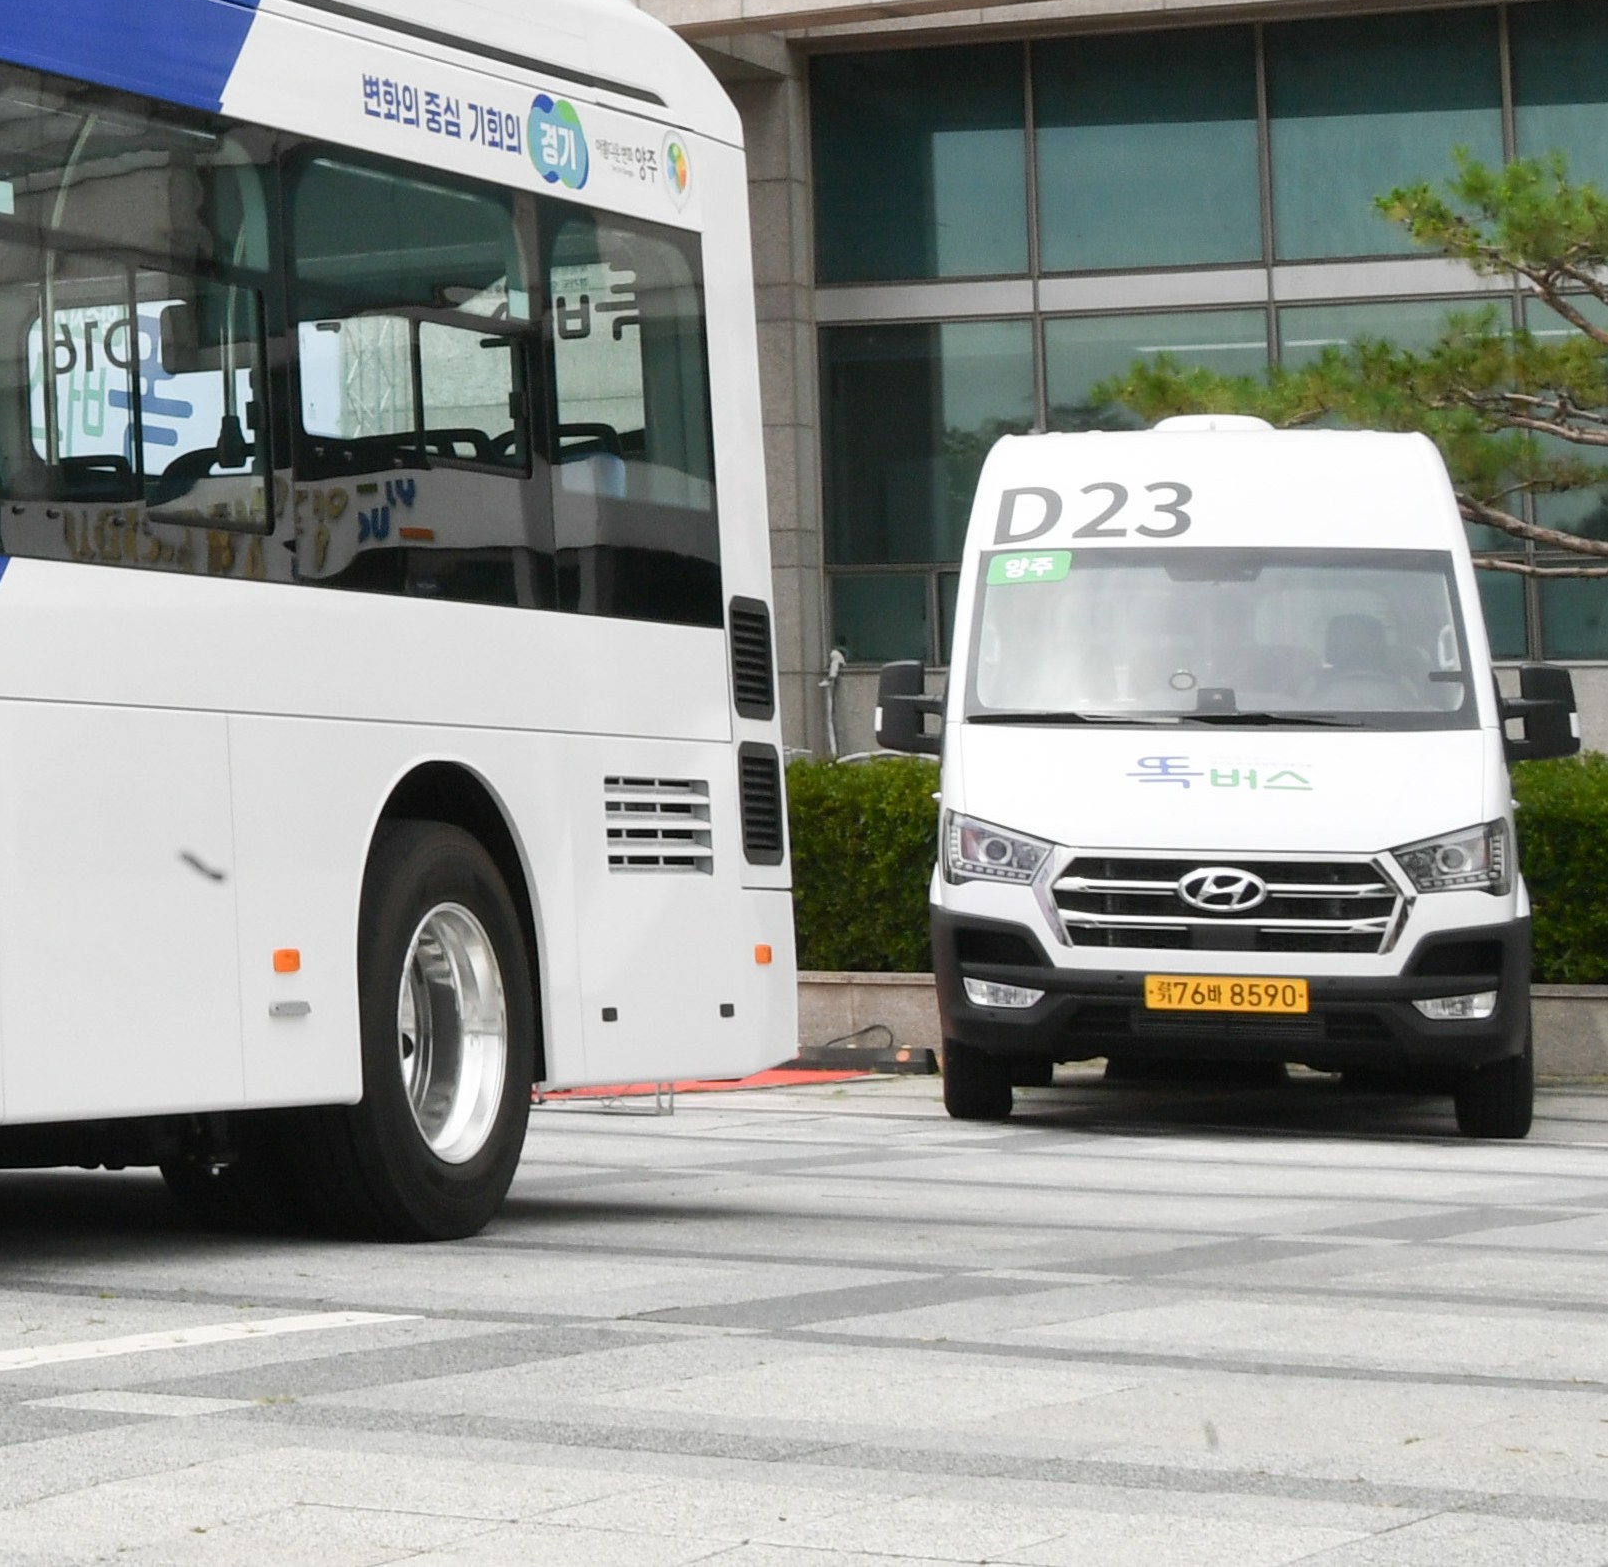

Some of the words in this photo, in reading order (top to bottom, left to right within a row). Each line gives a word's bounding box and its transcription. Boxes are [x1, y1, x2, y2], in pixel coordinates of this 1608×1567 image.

[362, 73, 420, 128] 변화의
[424, 90, 461, 139] 중심
[467, 102, 522, 155] 기회의
[539, 121, 577, 171] 경기
[635, 147, 658, 183] 양주
[992, 481, 1193, 545] D23
[1005, 557, 1054, 578] 양주
[1125, 756, 1314, 790] 똑버스
[1156, 980, 1172, 1005] 경기
[1173, 982, 1222, 1005] 76바
[1230, 983, 1297, 1008] 8590
